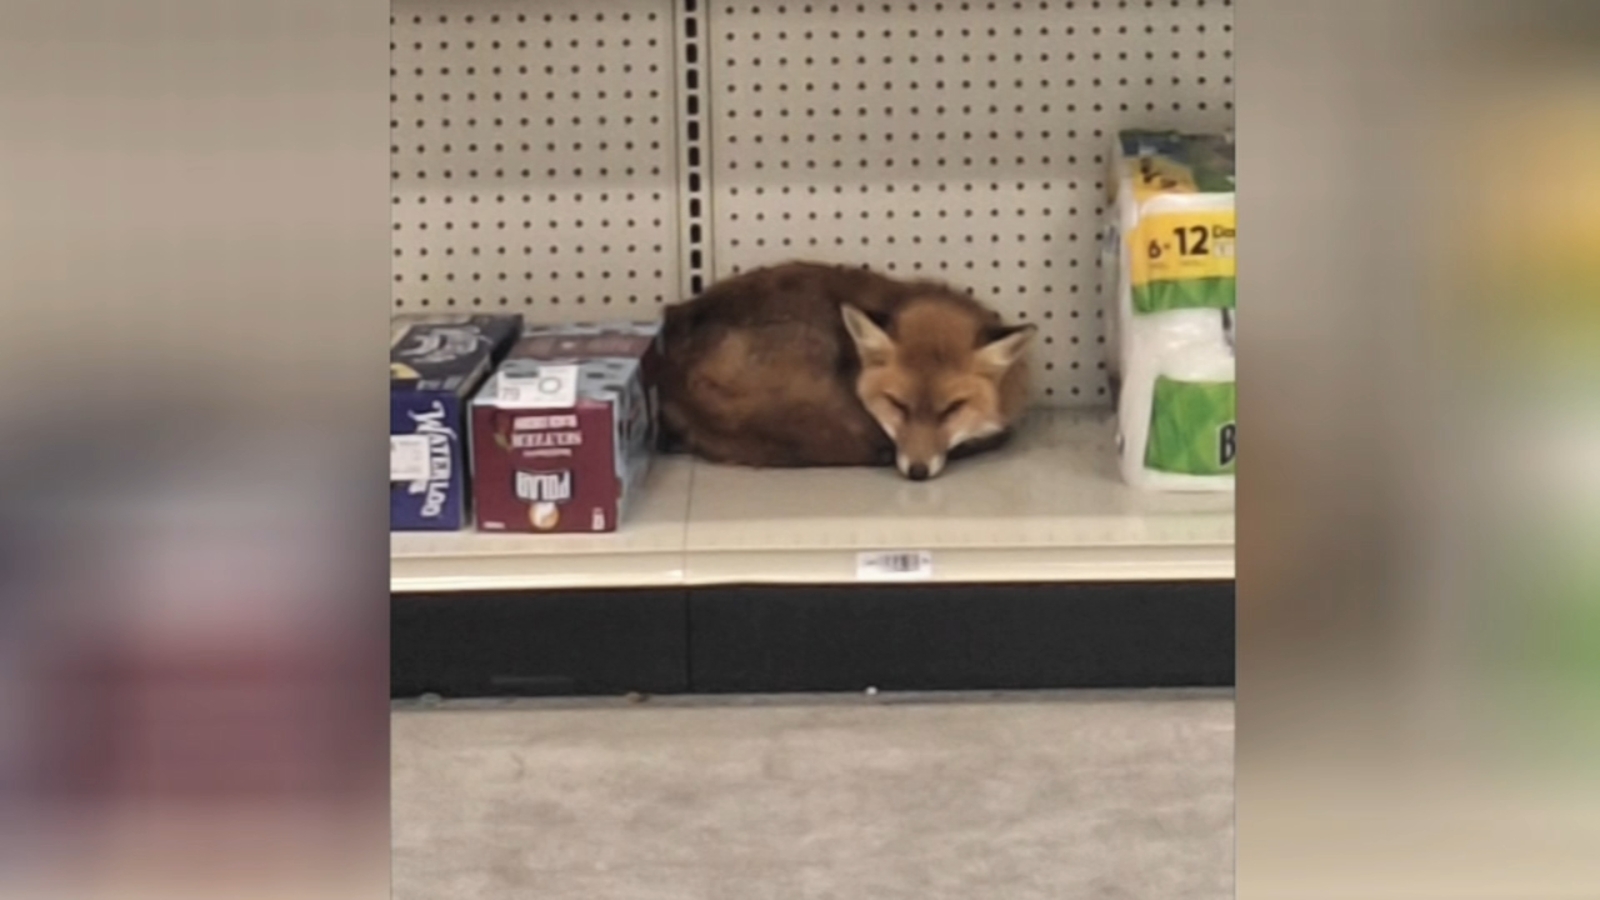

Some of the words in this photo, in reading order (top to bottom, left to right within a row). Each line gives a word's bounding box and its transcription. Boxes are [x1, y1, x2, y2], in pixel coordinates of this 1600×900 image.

[1173, 224, 1209, 256] 12
[407, 400, 457, 517] WATERLOO
[515, 469, 571, 501] POLAR
